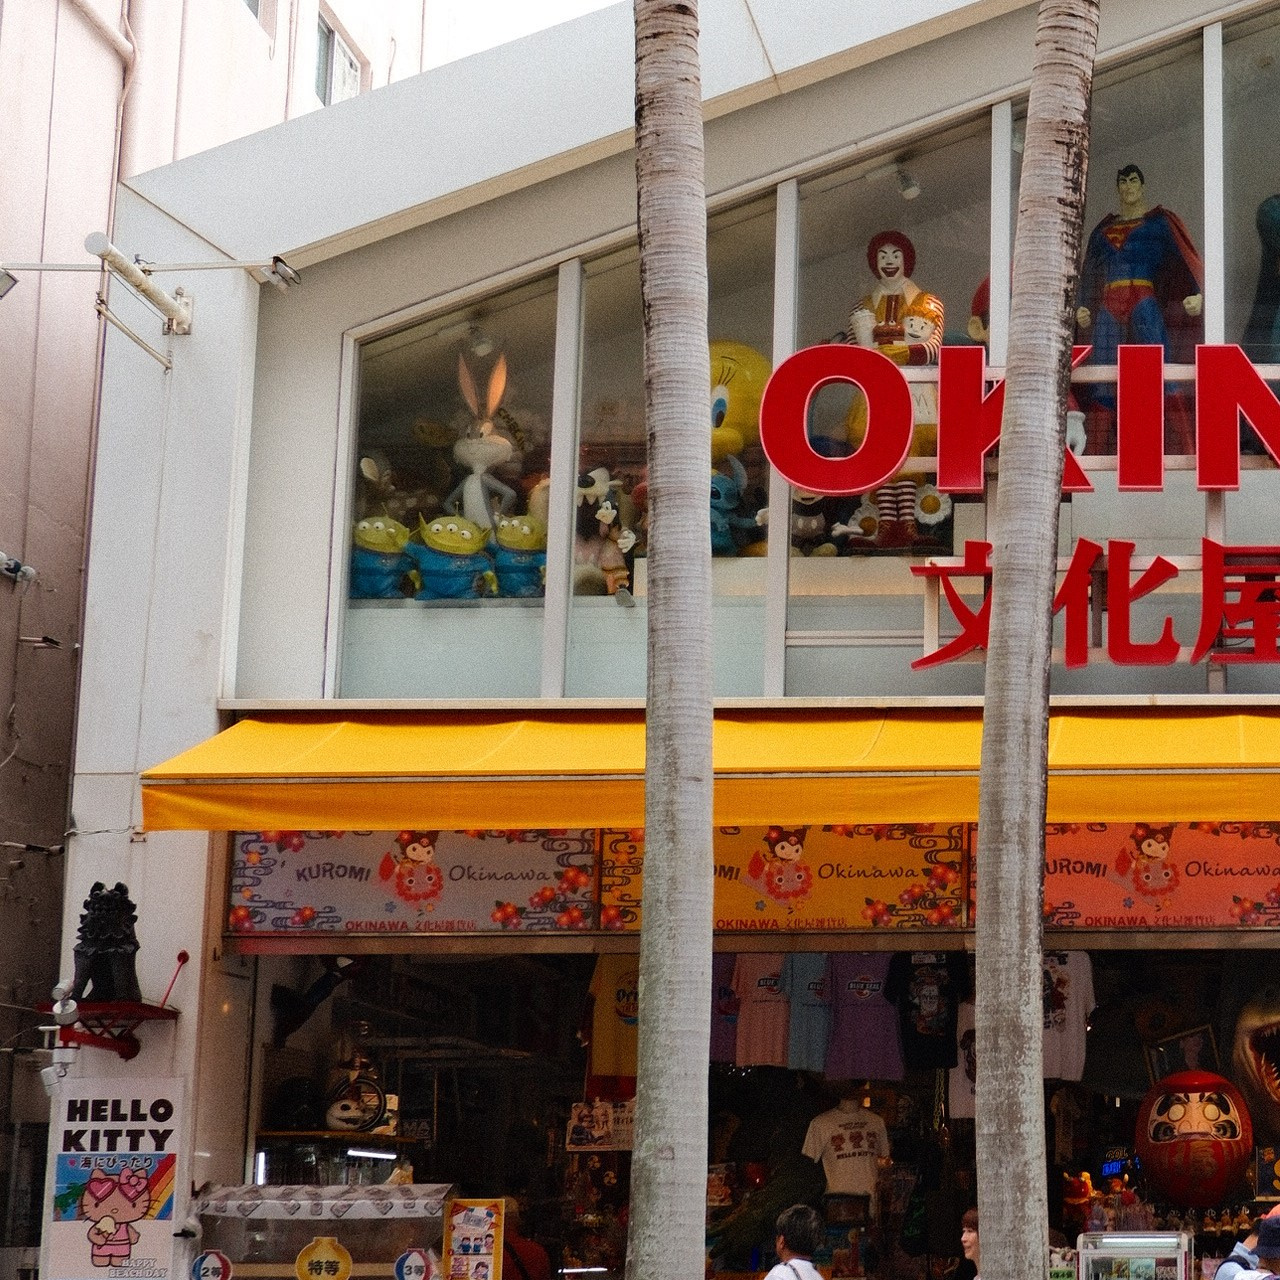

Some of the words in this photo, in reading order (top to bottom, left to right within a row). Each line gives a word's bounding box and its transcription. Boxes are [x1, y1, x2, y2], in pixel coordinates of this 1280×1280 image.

[295, 865, 371, 883] KUROMI
[449, 864, 551, 883] Okinawa
[818, 862, 919, 880] Okinawa
[1045, 858, 1108, 878] UROMI
[345, 920, 408, 931] OKINAWA
[717, 919, 779, 930] OKINAWA
[1085, 916, 1147, 927] OKINAWA
[616, 988, 638, 1003] Ori
[66, 1099, 174, 1122] HELLO
[62, 1129, 175, 1152] KITTY
[200, 1265, 223, 1277] 2等
[307, 1259, 340, 1276] 特等
[404, 1265, 425, 1276] 3等
